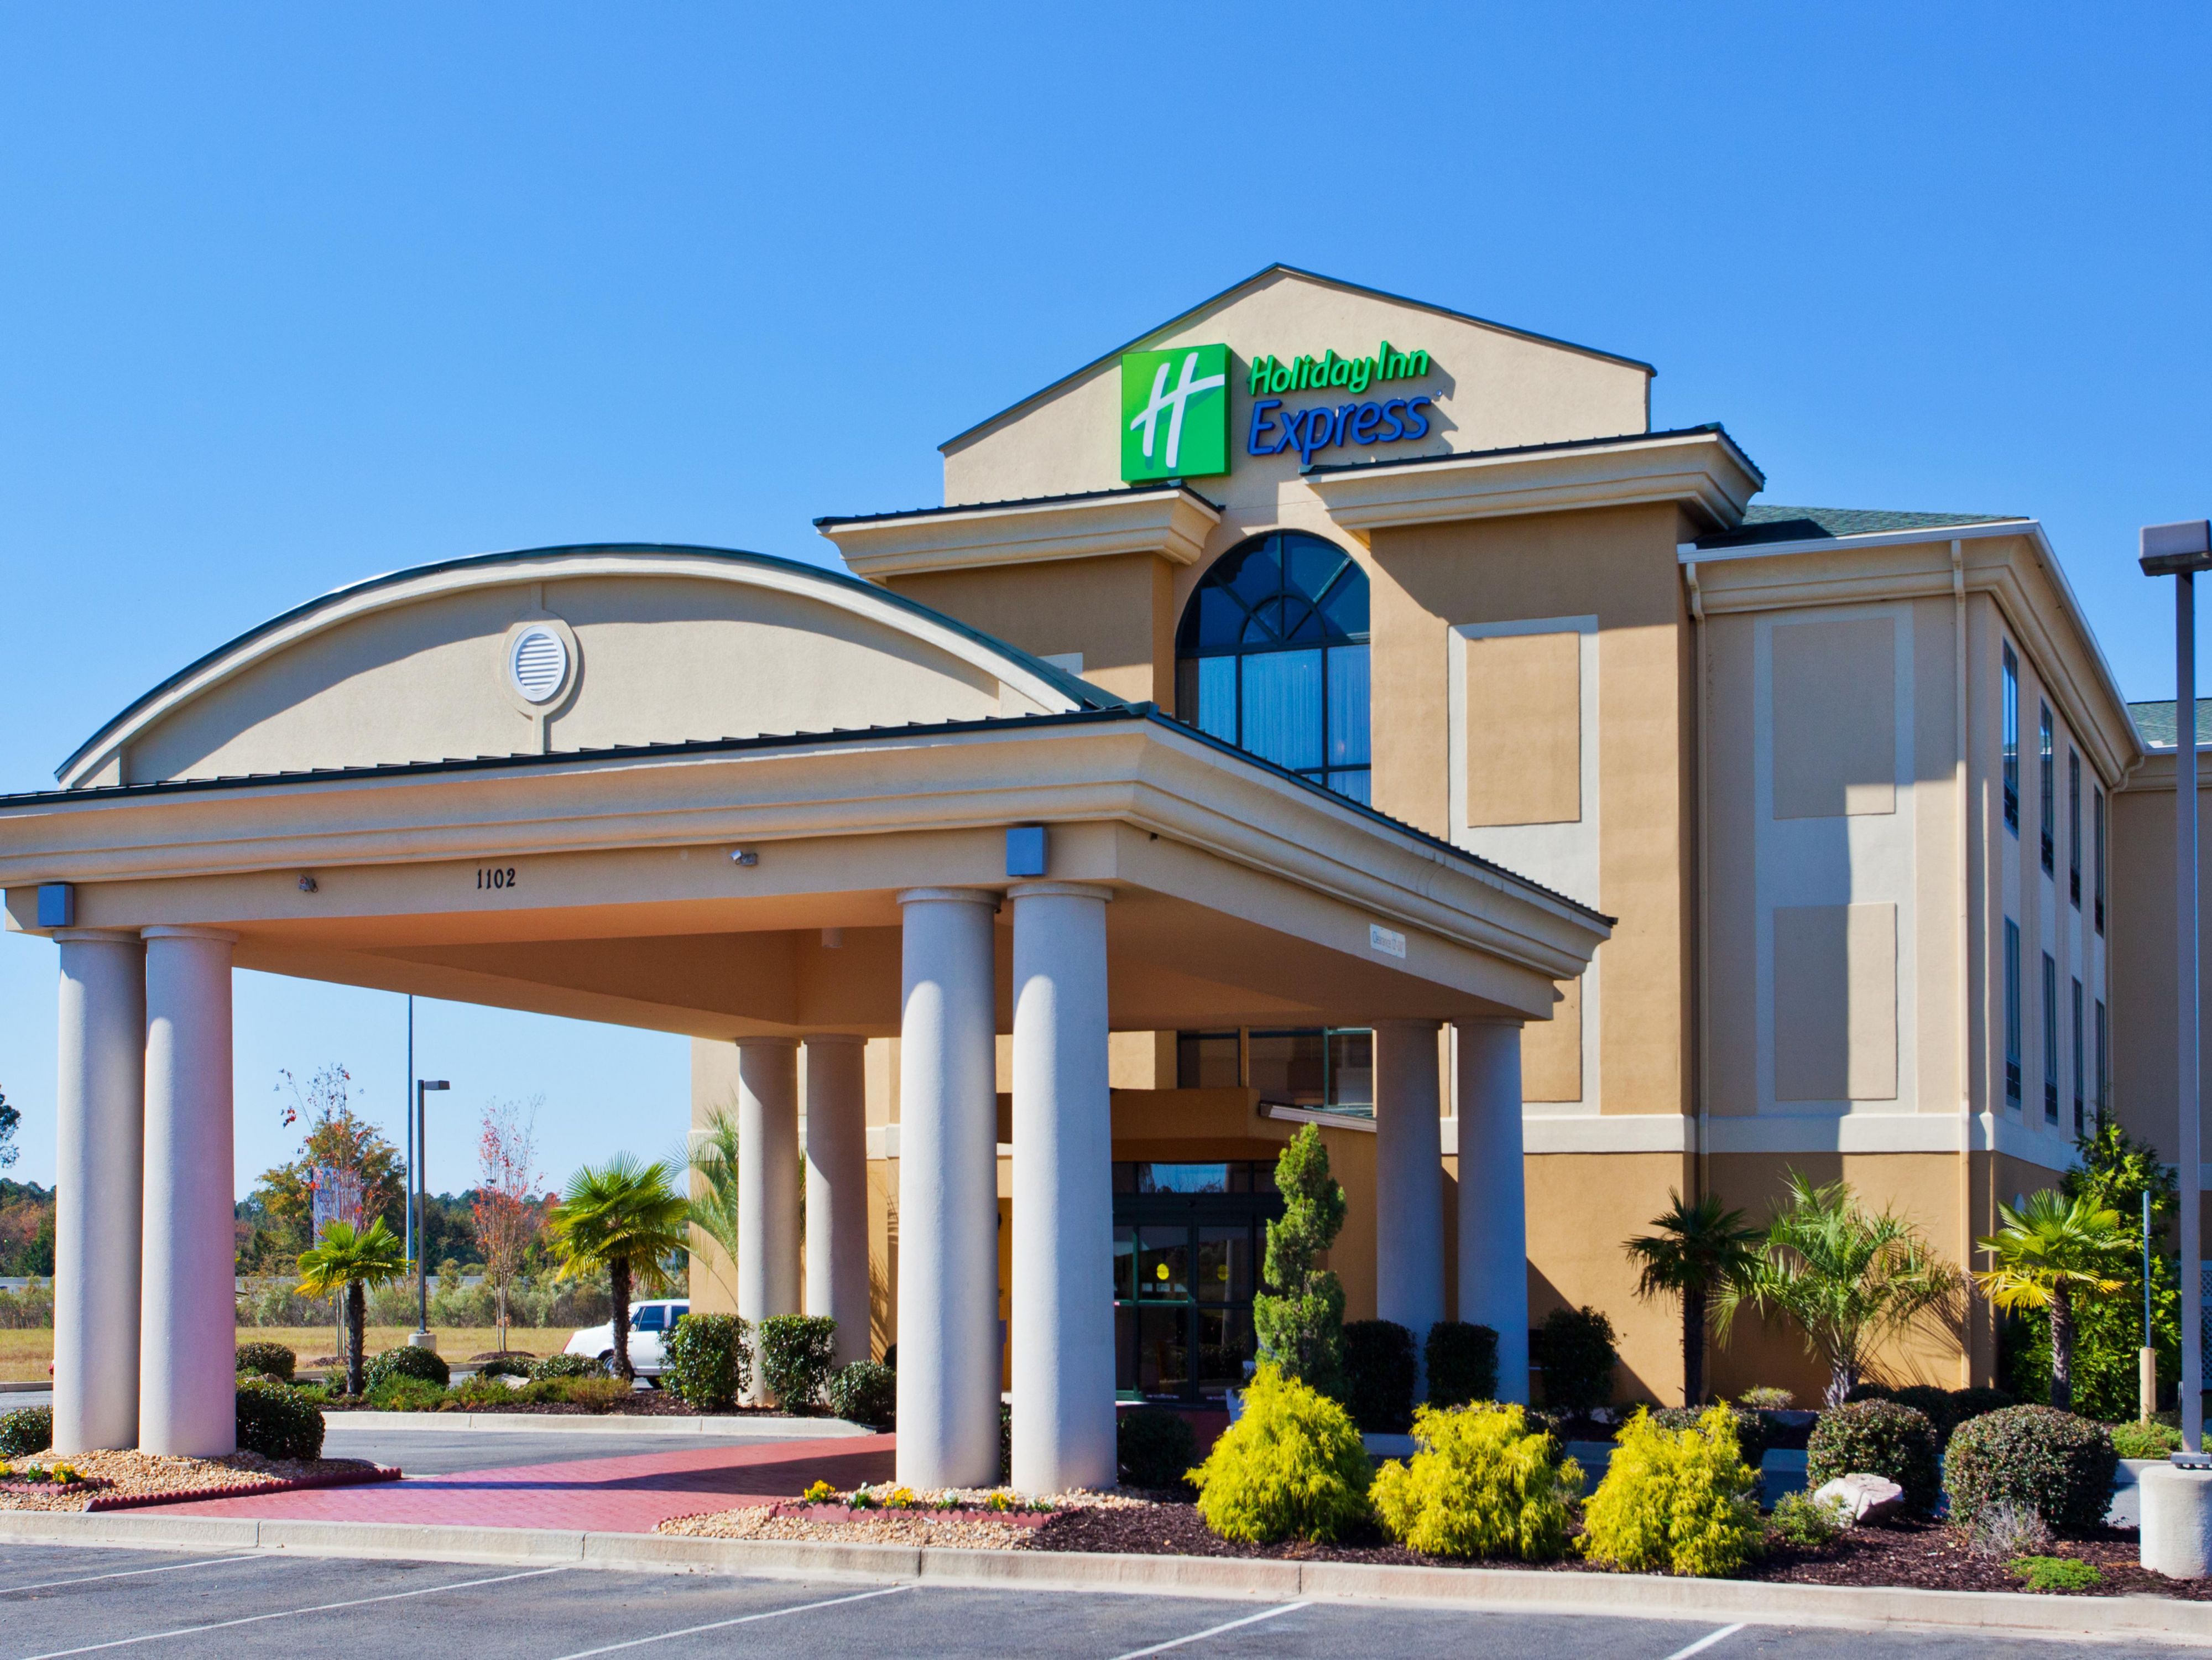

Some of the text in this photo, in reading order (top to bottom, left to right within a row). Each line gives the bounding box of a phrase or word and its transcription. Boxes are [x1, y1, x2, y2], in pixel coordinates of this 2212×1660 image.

[1248, 341, 1430, 395] Holiday Inn
[1130, 352, 1225, 468] H
[1247, 397, 1431, 465] Express
[477, 868, 515, 889] 1102
